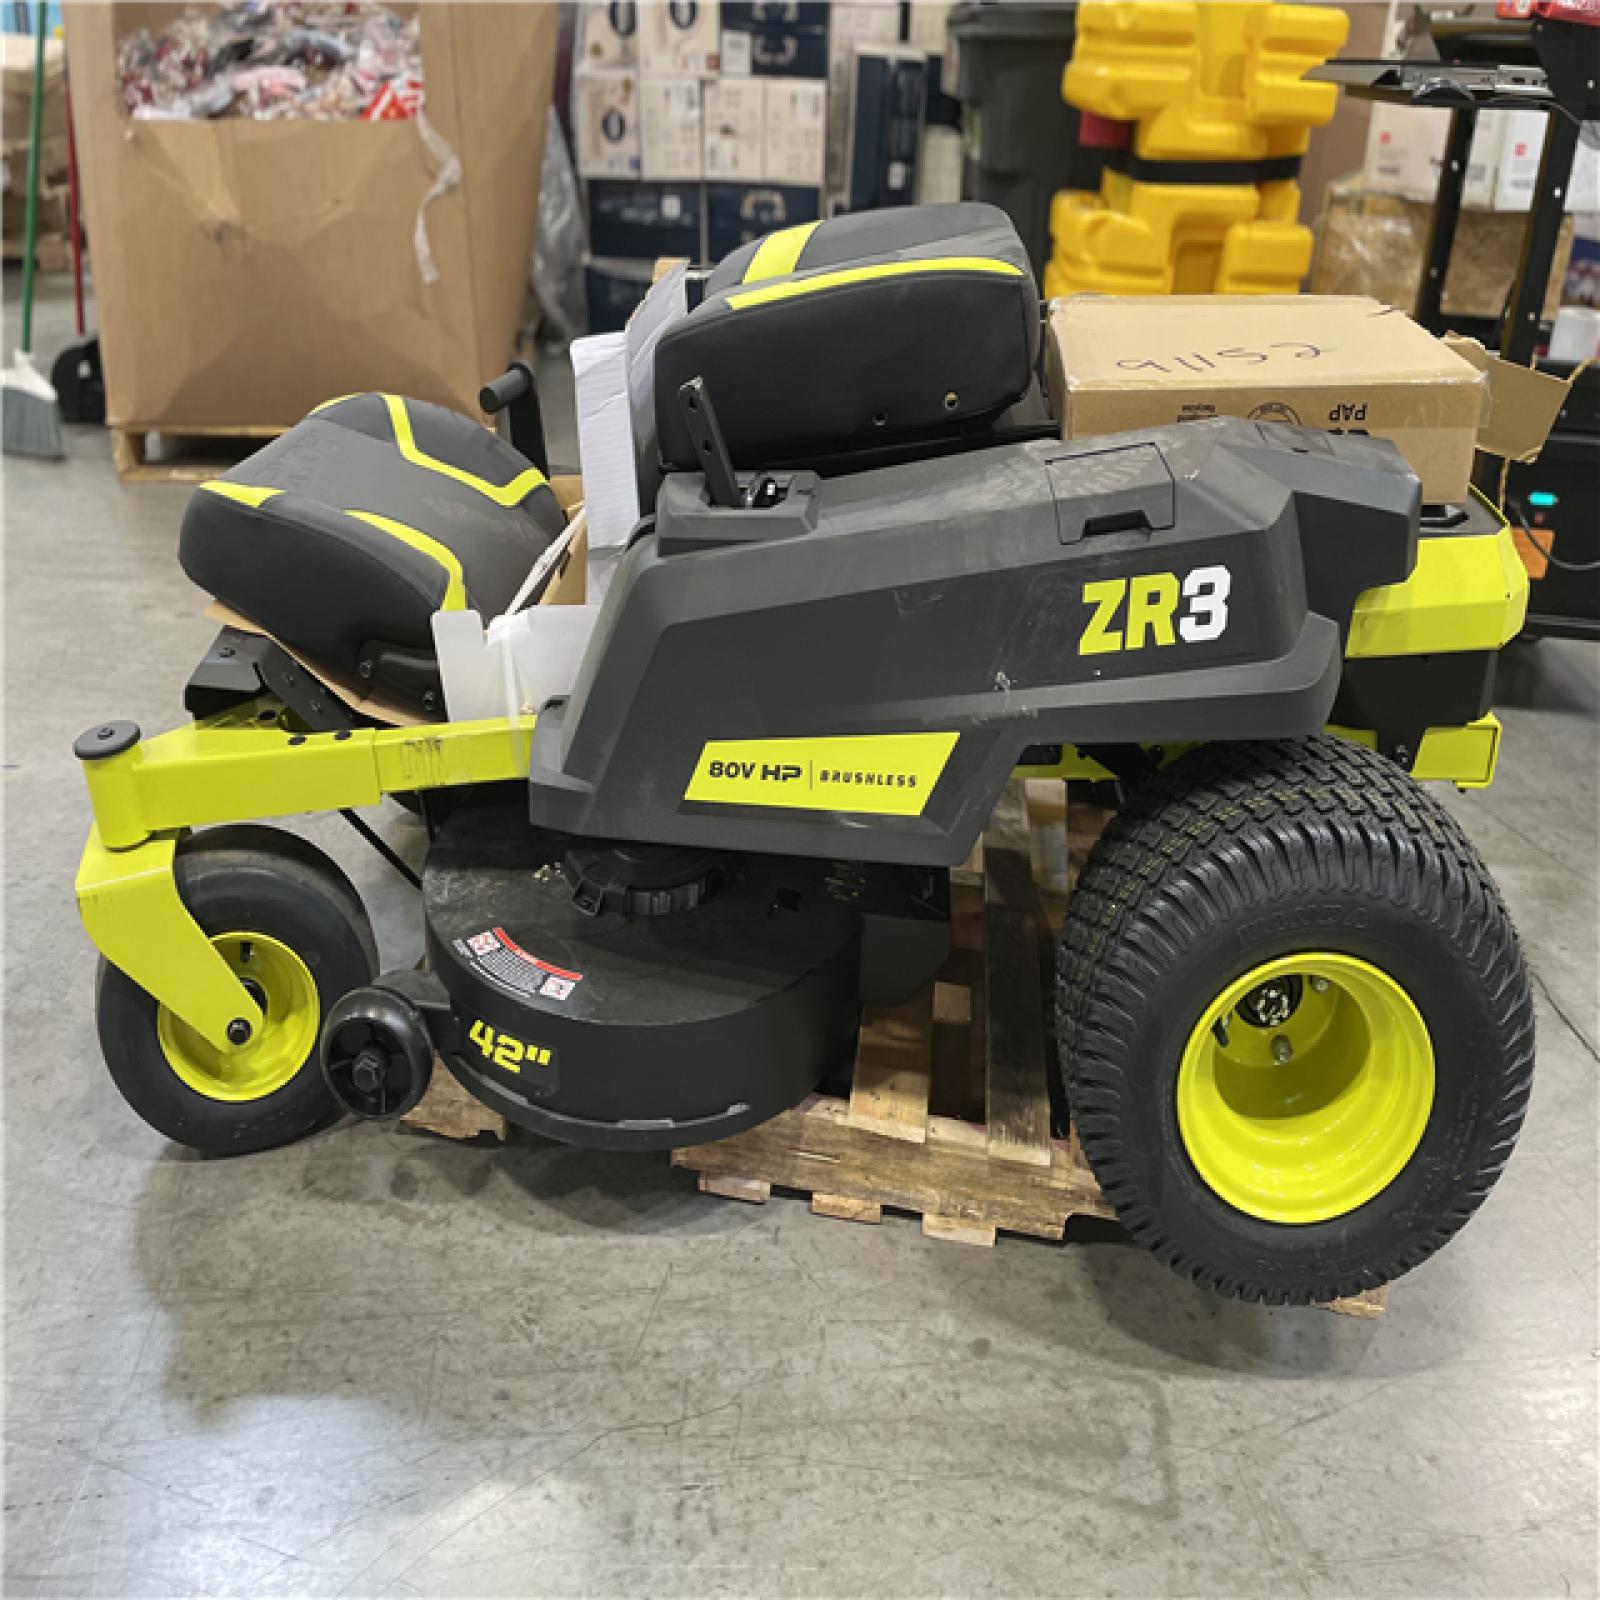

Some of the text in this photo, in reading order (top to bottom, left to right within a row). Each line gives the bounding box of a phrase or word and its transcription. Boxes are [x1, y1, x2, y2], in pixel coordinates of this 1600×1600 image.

[1329, 404, 1368, 421] PAP
[1078, 564, 1231, 655] ZR3
[709, 761, 918, 788] 80V HP BRUSHLESS
